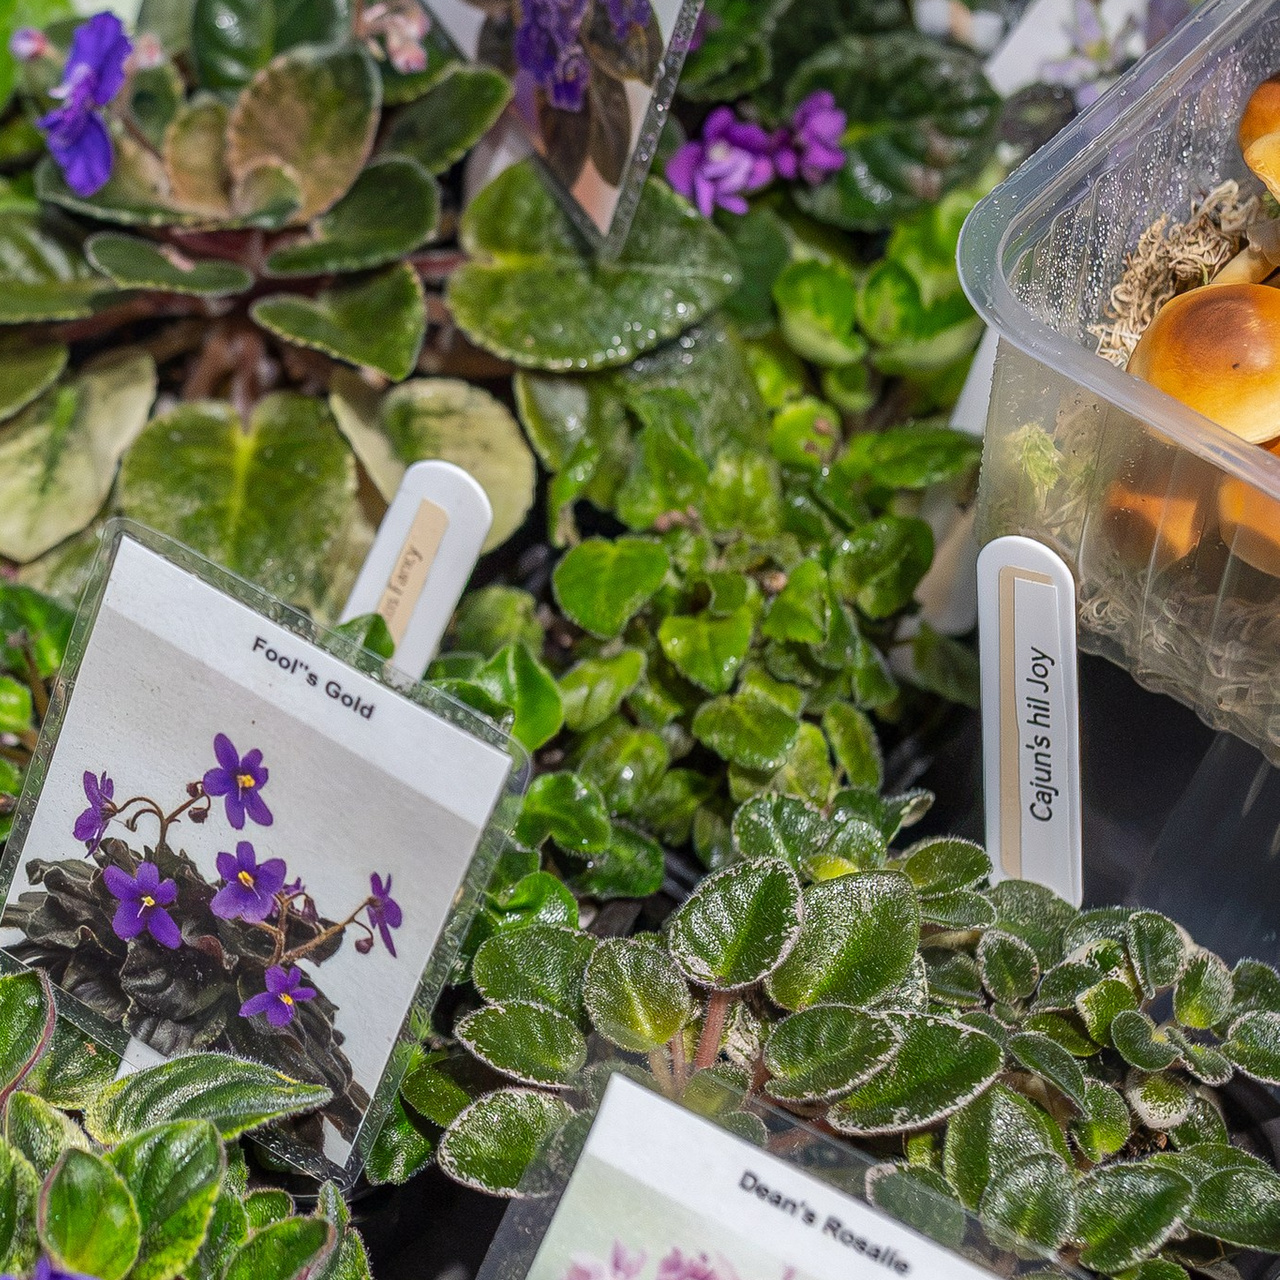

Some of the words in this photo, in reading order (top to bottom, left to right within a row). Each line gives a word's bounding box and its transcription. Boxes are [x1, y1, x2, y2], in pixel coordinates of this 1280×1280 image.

[1026, 646, 1055, 694] Joy
[325, 681, 375, 721] Gold
[1026, 696, 1050, 728] hil
[1026, 733, 1059, 822] Cajun's
[739, 1170, 816, 1227] Dean's
[822, 1214, 911, 1277] Rosalie
